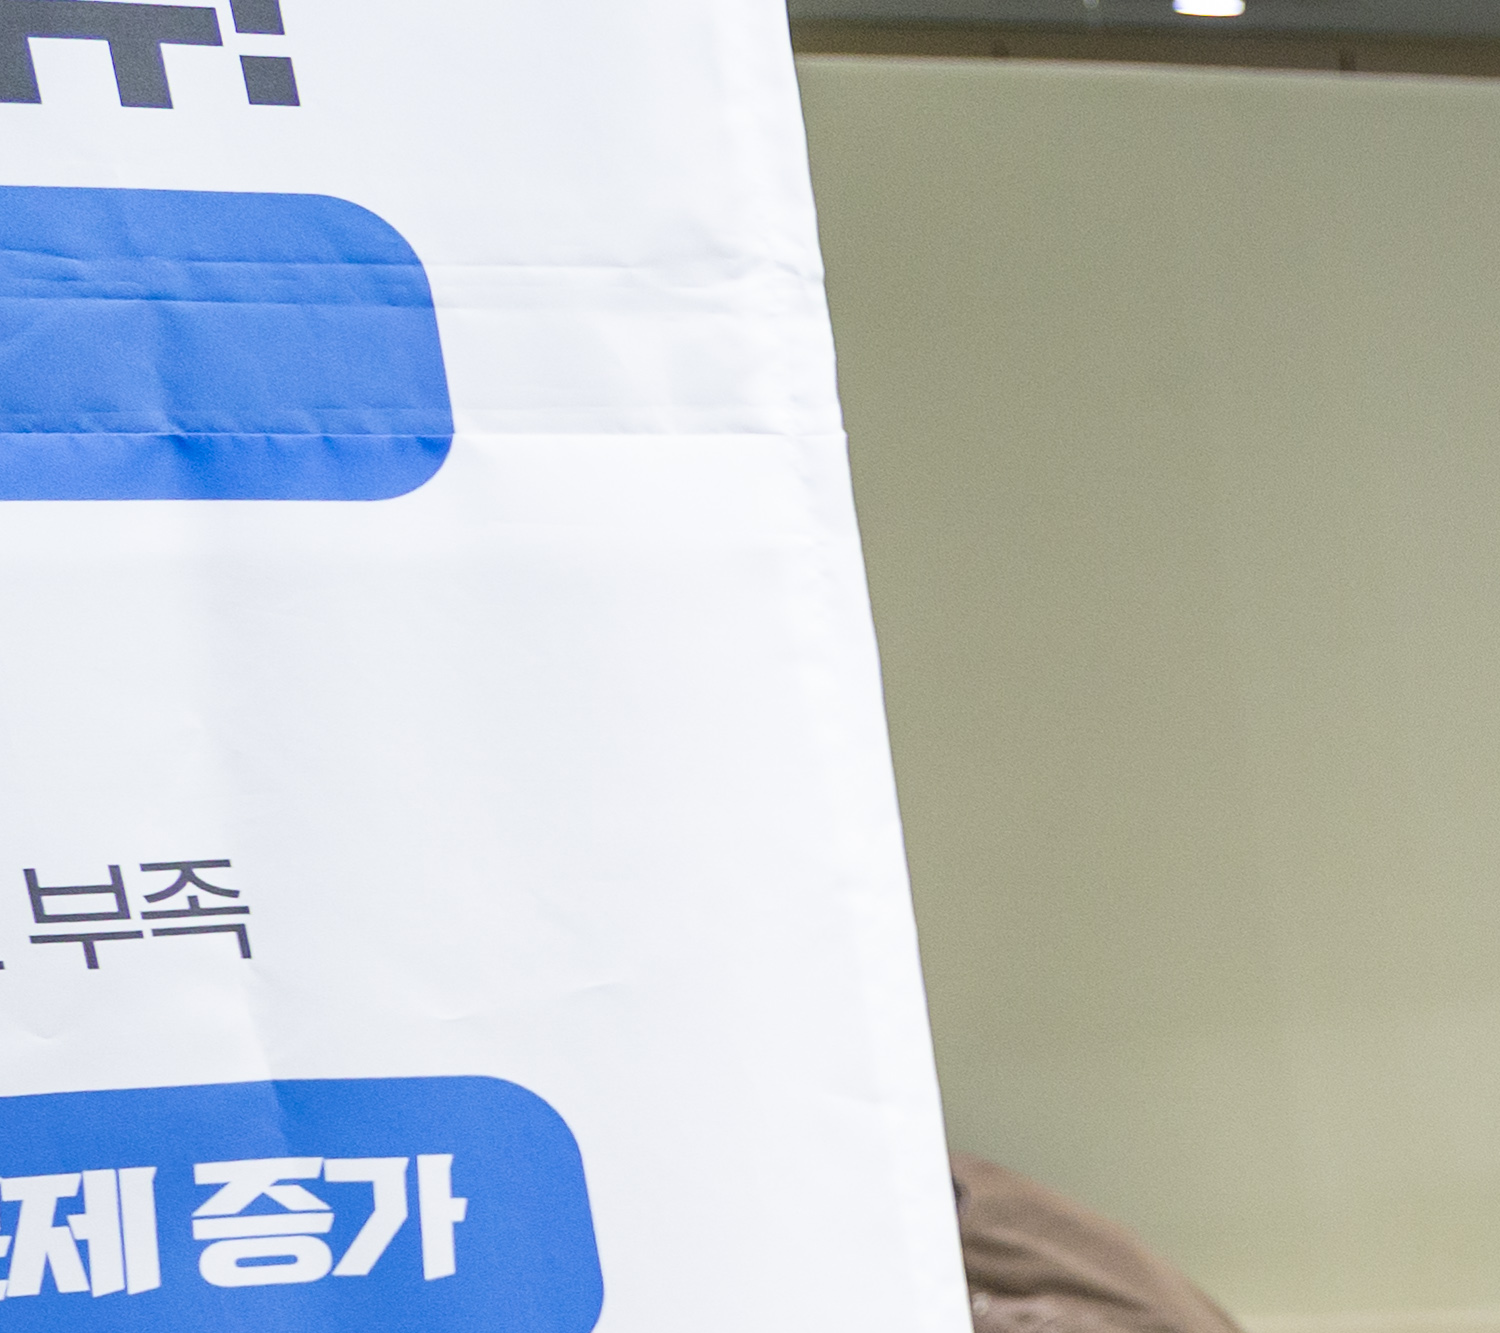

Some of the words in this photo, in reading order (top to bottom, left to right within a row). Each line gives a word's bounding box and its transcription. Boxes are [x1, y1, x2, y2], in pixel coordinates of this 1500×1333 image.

[23, 859, 252, 970] 부족
[0, 1166, 161, 1300] 제
[191, 1153, 468, 1288] 증가
